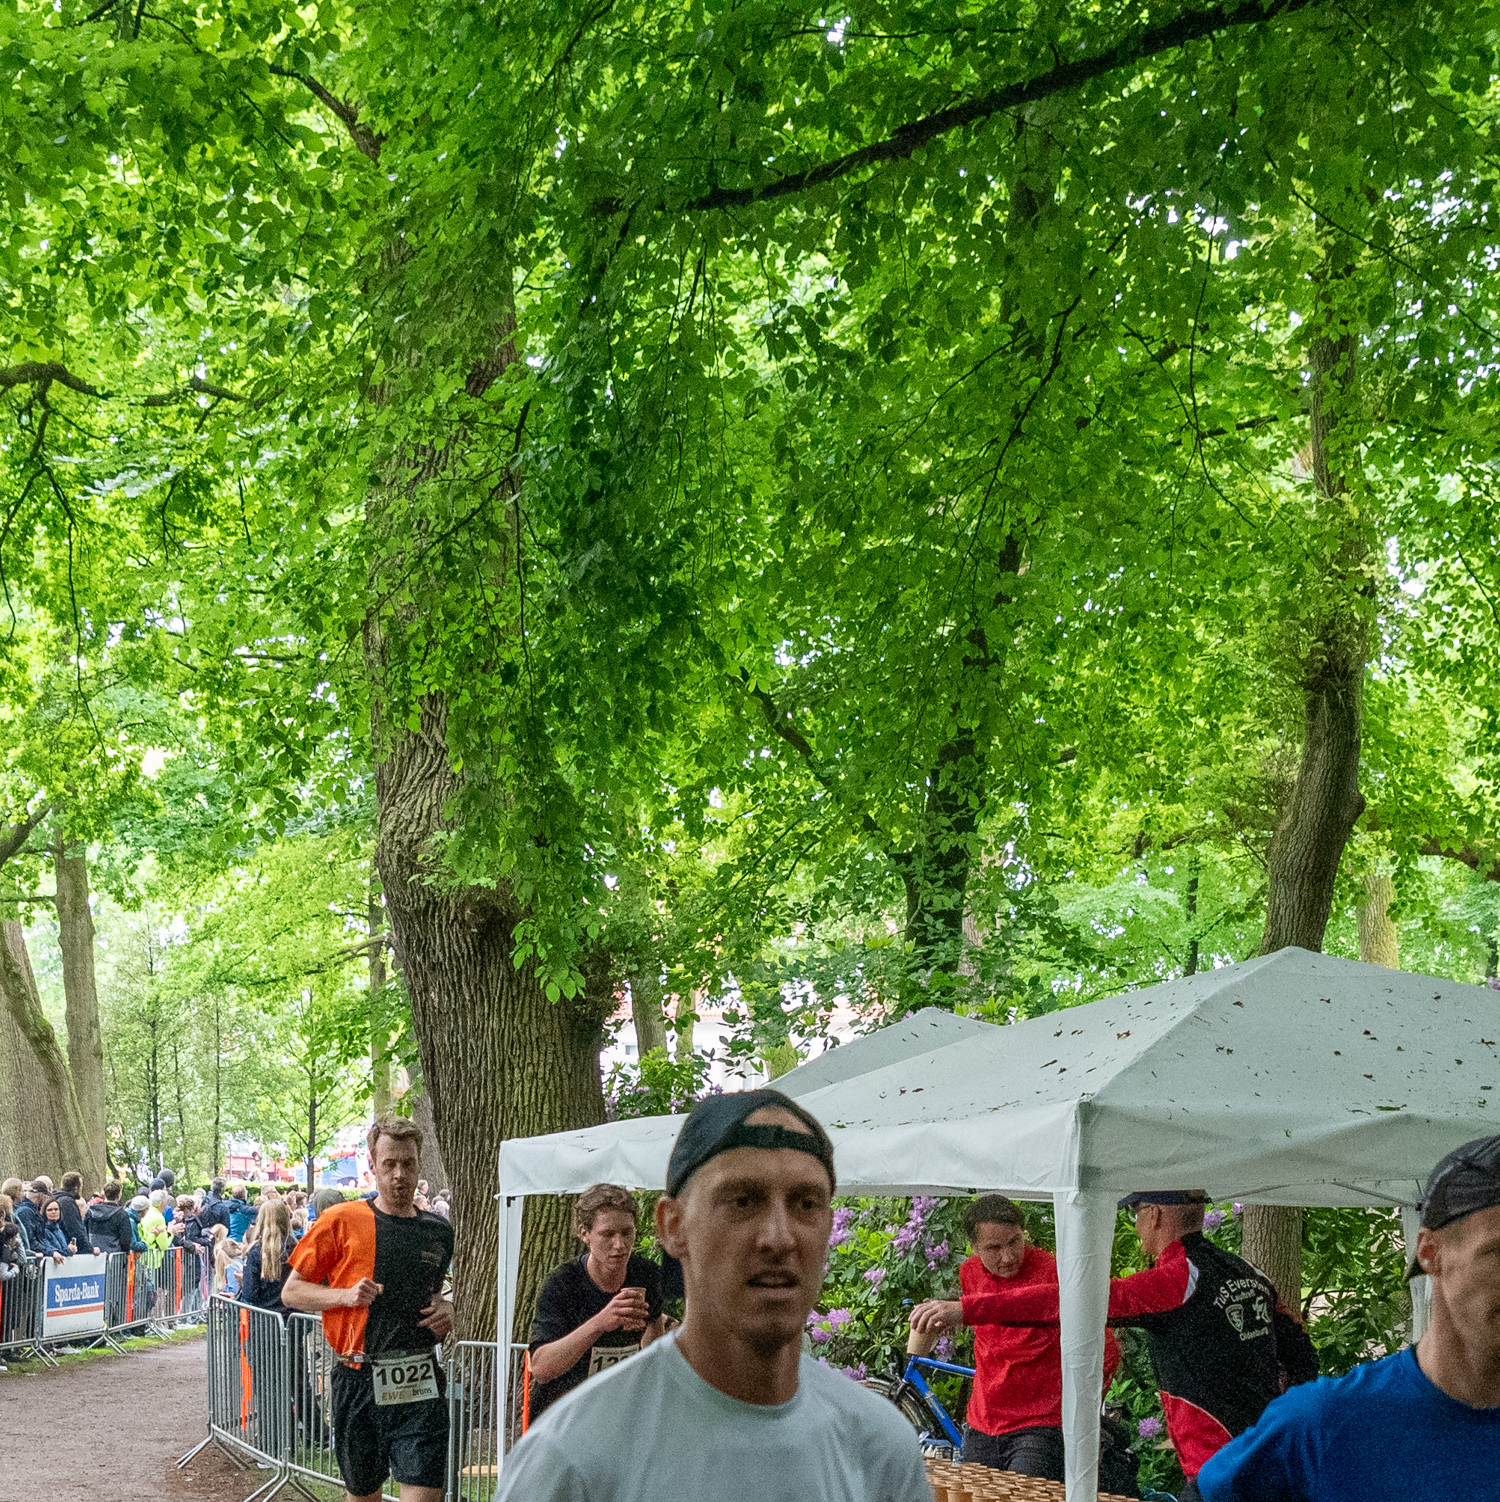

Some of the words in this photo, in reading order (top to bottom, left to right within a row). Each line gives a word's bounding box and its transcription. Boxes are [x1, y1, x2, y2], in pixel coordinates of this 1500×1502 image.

[54, 1281, 100, 1307] Sparda-Bank
[1213, 1287, 1230, 1309] TuS
[376, 1362, 433, 1386] 1022
[381, 1390, 405, 1401] EWE
[412, 1387, 433, 1397] bruns
